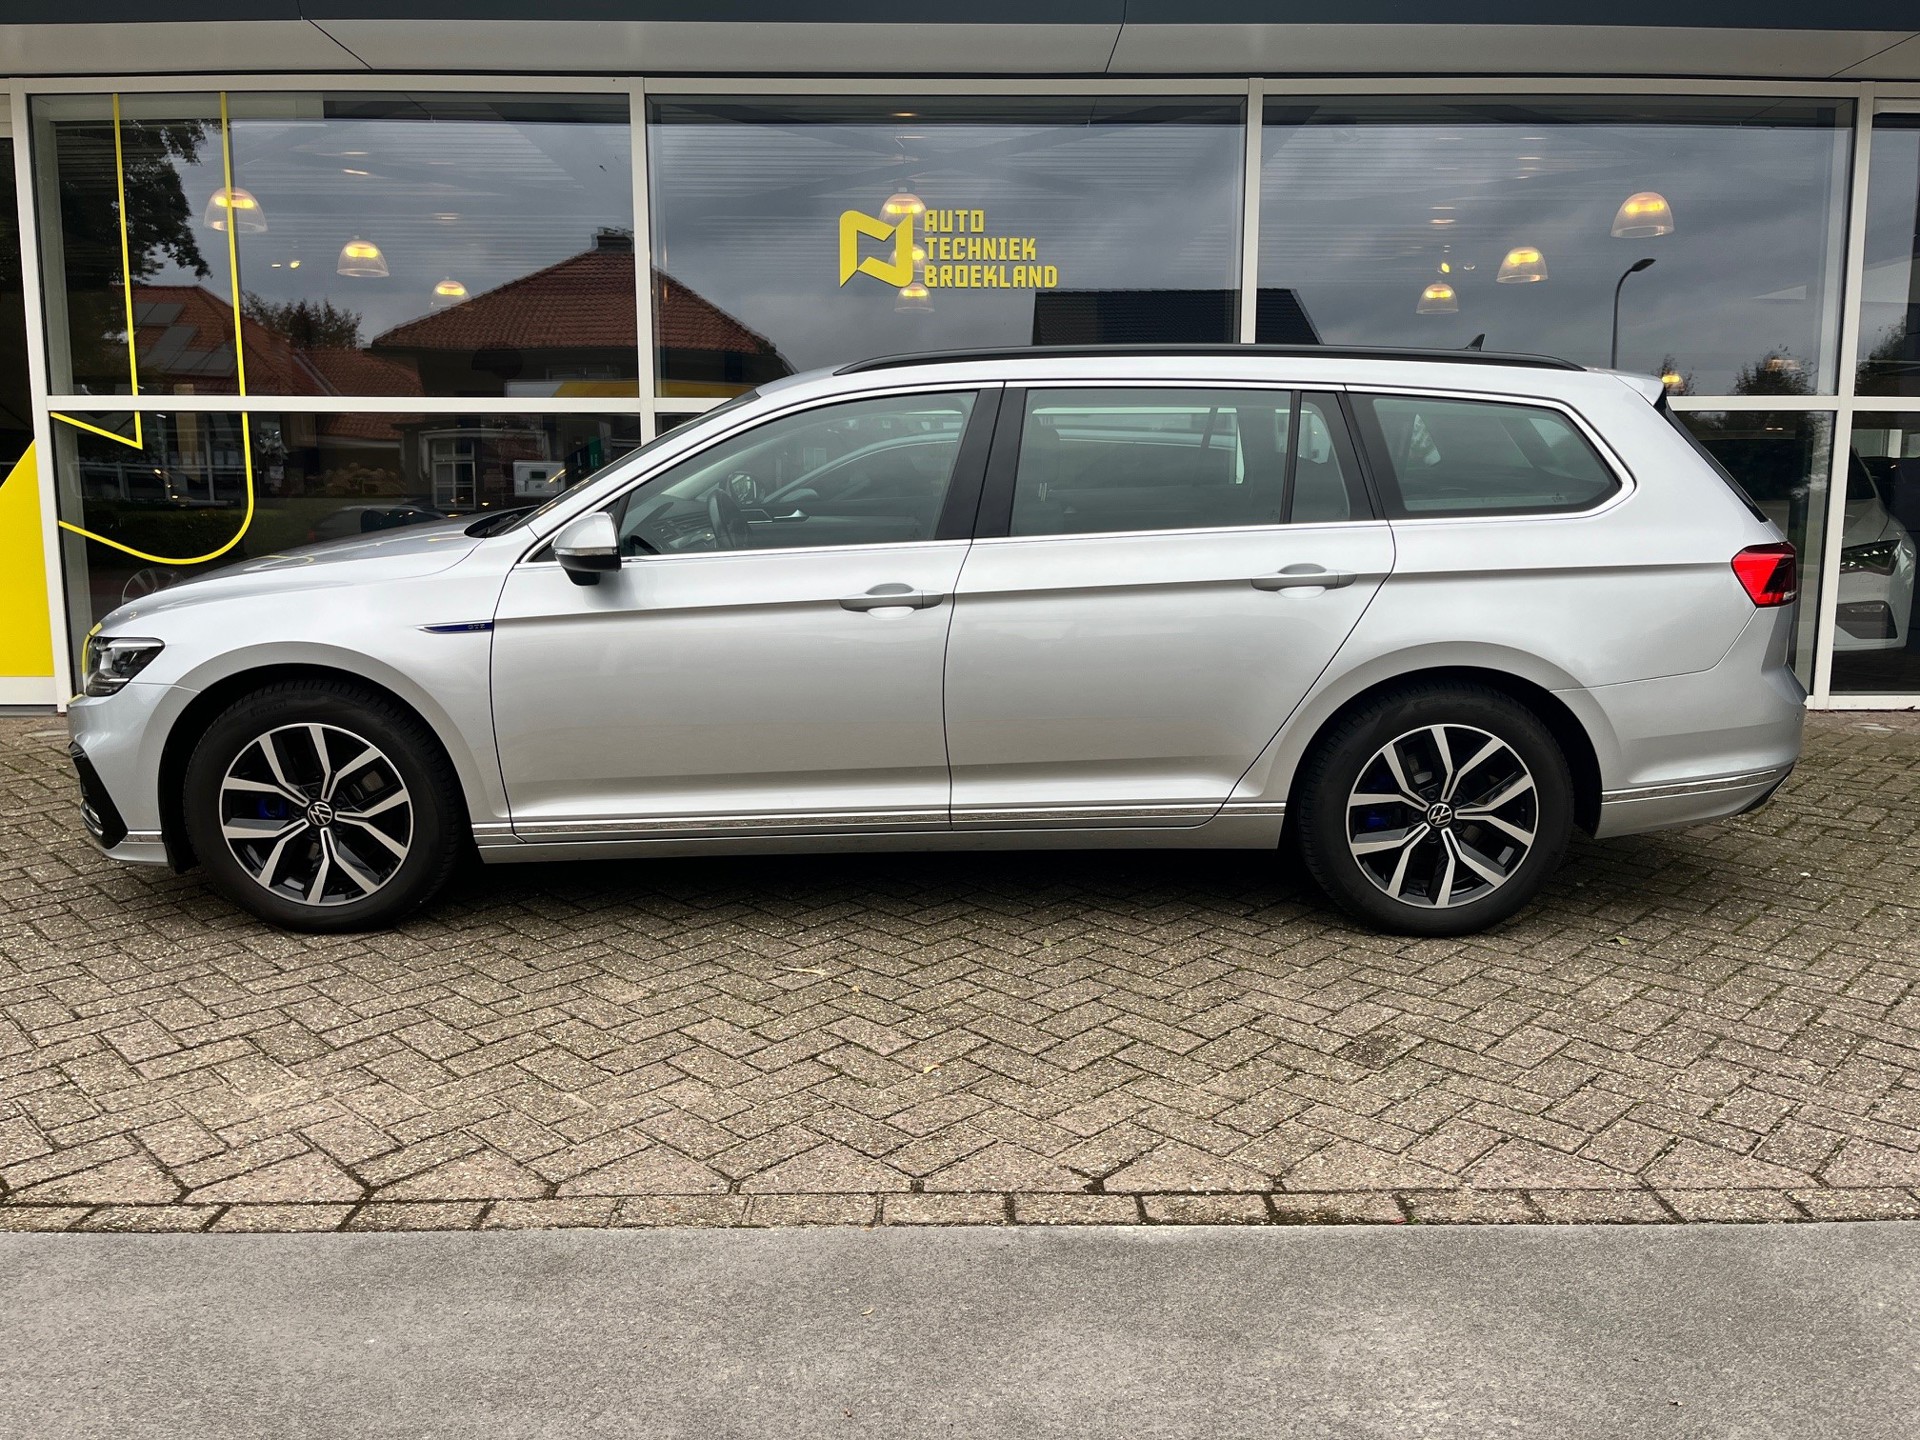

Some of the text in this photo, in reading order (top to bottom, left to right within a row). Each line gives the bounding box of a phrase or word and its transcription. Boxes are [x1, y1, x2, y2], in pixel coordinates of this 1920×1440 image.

[924, 210, 984, 232] AUTO
[924, 237, 1036, 260] TECHNIEK
[924, 265, 1058, 288] BROEKLAND
